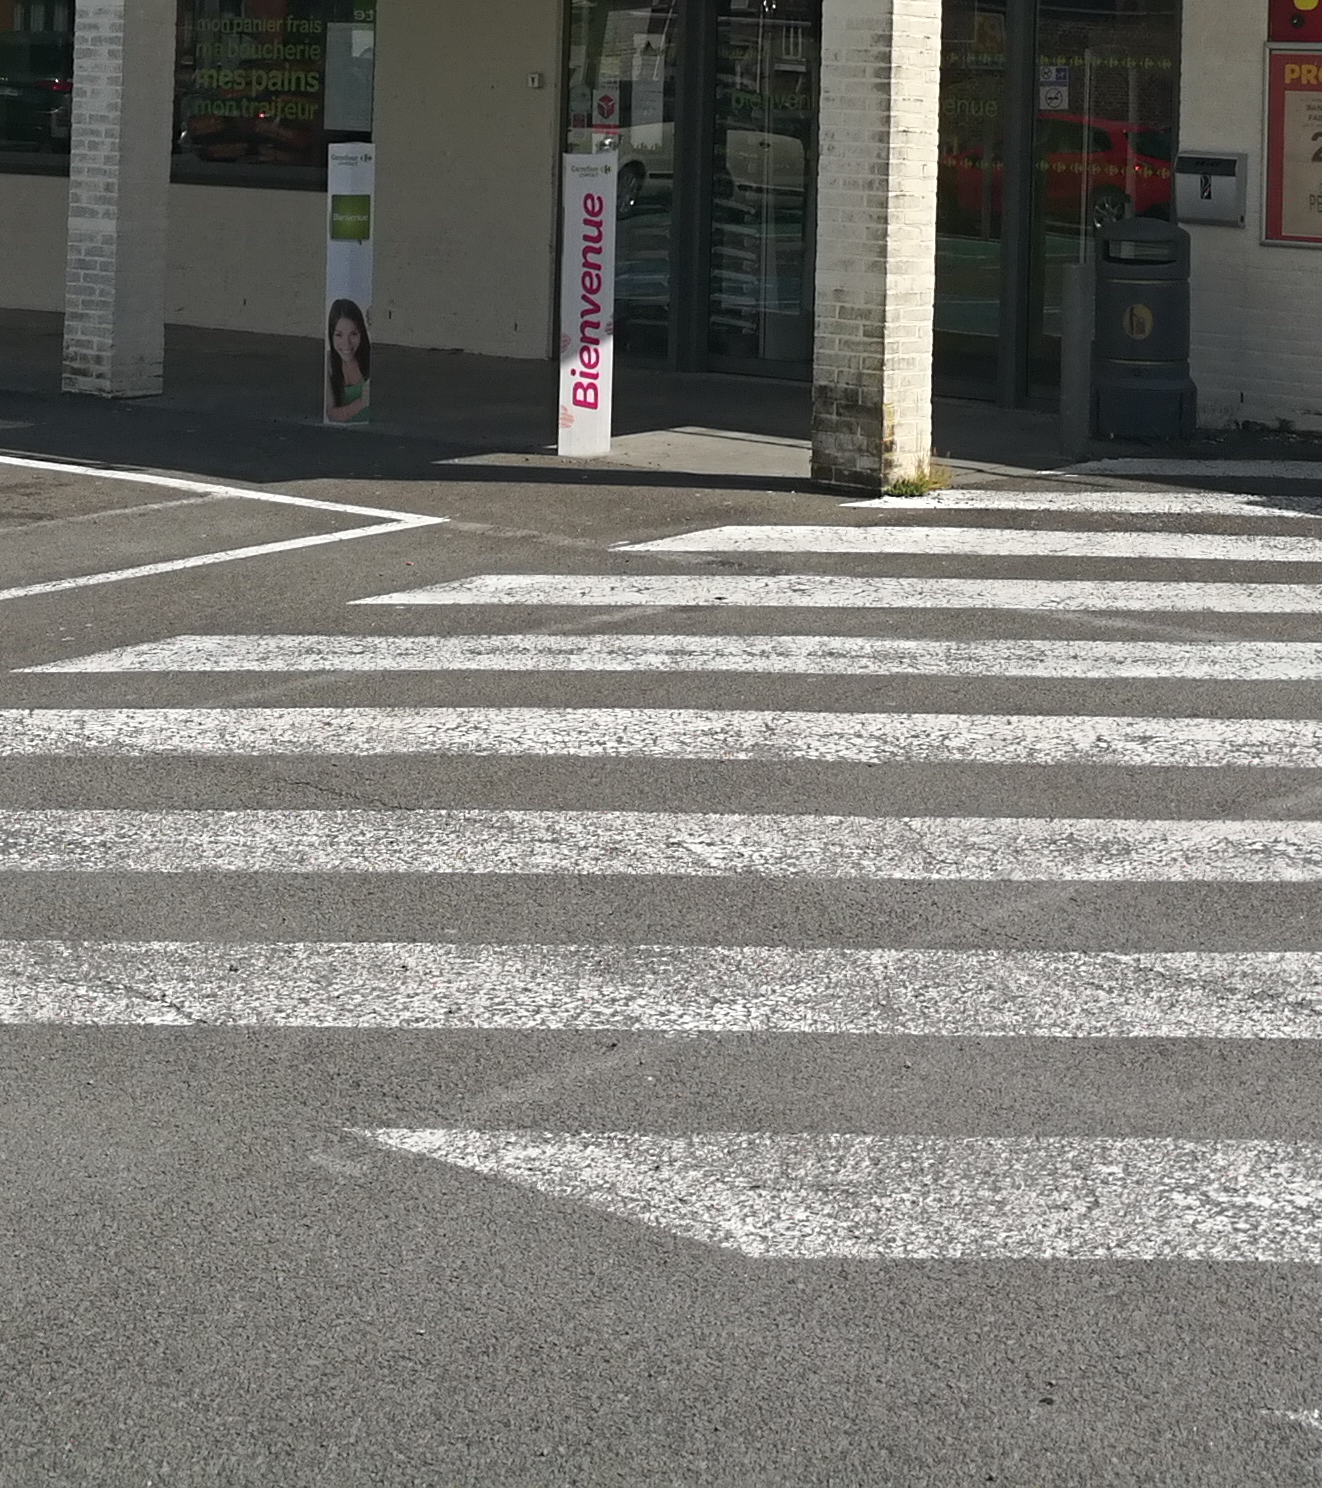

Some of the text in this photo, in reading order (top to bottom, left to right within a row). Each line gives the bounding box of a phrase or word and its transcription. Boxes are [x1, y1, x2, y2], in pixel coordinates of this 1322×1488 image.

[197, 14, 322, 35] mon panier frais
[228, 39, 321, 60] boucherie
[195, 63, 321, 96] mes pains
[195, 95, 319, 120] mon traiteur
[572, 193, 604, 410] Bienvenue
